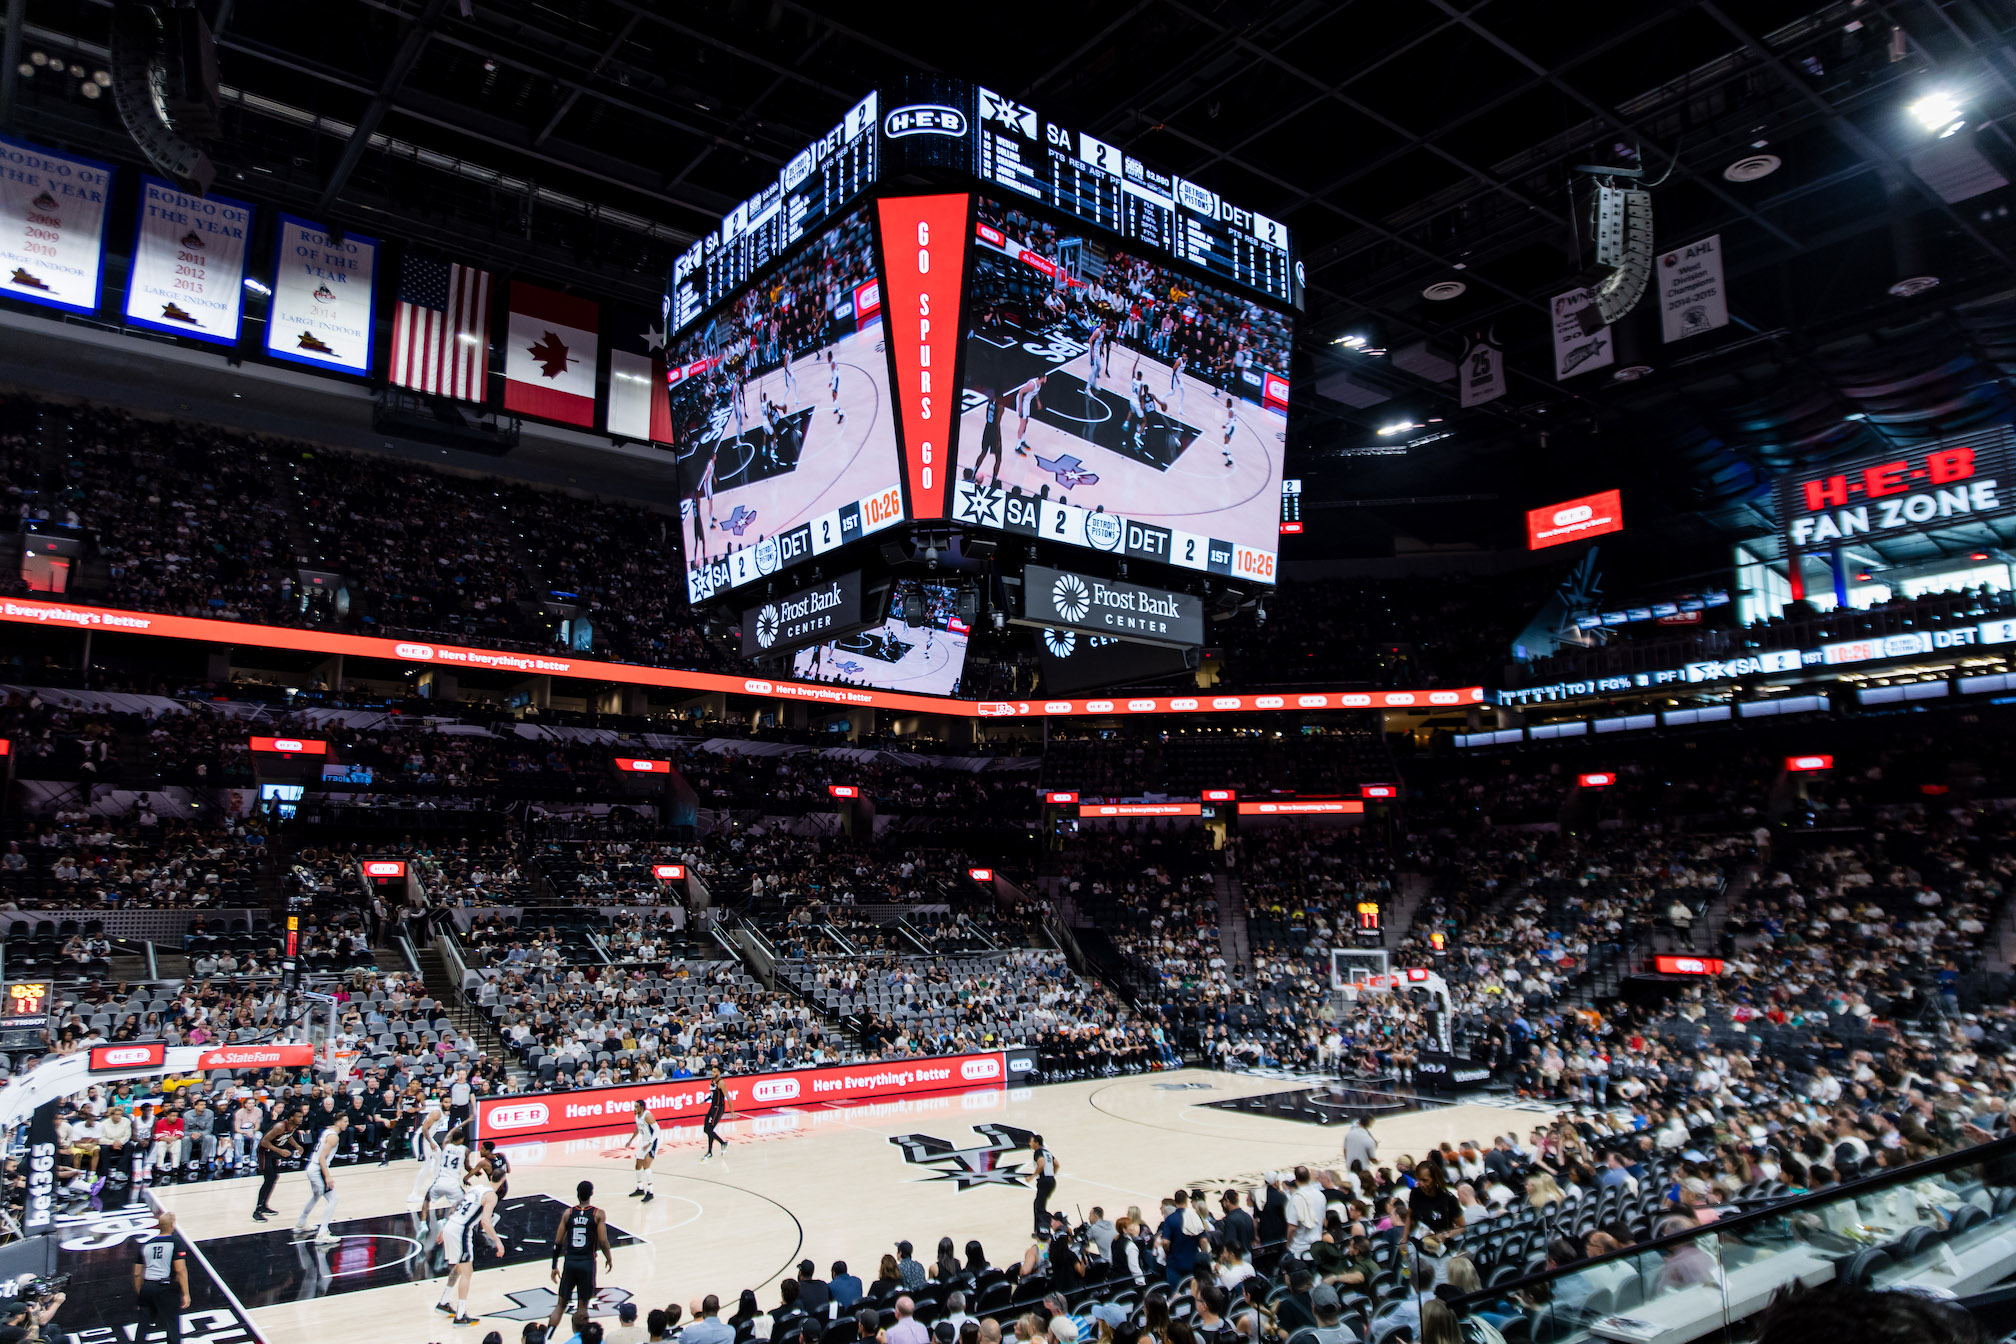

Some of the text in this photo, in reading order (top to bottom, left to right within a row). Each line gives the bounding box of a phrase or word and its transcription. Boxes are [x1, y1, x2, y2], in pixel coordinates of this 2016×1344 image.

[858, 103, 866, 133] 2
[892, 111, 959, 132] H-E-B
[817, 122, 844, 162] DET
[1047, 122, 1071, 151] SA
[822, 124, 876, 173] PTS REB AST PF
[1096, 143, 1107, 170] 2
[1048, 147, 1121, 185] PTS REB AST PF
[0, 166, 102, 203] THE YEAR
[79, 171, 107, 185] OF
[1184, 184, 1209, 202] DETROIT
[1184, 195, 1210, 212] PISTONS
[148, 187, 247, 223] RODEO OF
[1222, 201, 1252, 230] DET
[148, 205, 243, 240] THE YEAR
[732, 212, 739, 237] 2
[1267, 222, 1277, 244] 2
[25, 226, 60, 243] 2009
[704, 231, 720, 256] SA
[1228, 227, 1287, 258] PTS REB AST PF
[24, 241, 57, 258] 2010
[177, 250, 206, 267] 2011
[296, 246, 358, 271] OF THE
[1686, 242, 1715, 260] AHL
[35, 259, 86, 278] INDOOR
[175, 264, 205, 280] 2012
[305, 263, 347, 284] YEAR
[1672, 269, 1708, 287] Division
[1678, 262, 1702, 275] West
[173, 278, 203, 294] 2013
[1667, 276, 1716, 297] Champions
[144, 285, 228, 311] LARGE INDOOR
[310, 305, 337, 320] 2014
[281, 312, 361, 338] LARGE INDOOR
[917, 221, 934, 490] GO SPURS GO
[1471, 351, 1491, 377] 25
[1286, 481, 1293, 492] 2
[1803, 447, 1976, 511] H-E-B
[864, 489, 901, 527] 10:26
[1790, 479, 2000, 546] FAN ZONE
[842, 513, 860, 532] 1ST
[1091, 525, 1116, 540] PISTONS
[1092, 518, 1117, 531] DETROIT
[782, 529, 809, 560] DET
[822, 523, 830, 546] 2
[1006, 498, 1273, 577] SA 2 DET 2 1ST 10:26
[738, 556, 746, 578] 2
[713, 569, 730, 589] SA
[780, 581, 842, 624] Frost Bank
[1092, 582, 1181, 620] Frost Bank
[5, 603, 151, 629] Everything's Better
[787, 615, 832, 638] CENTER
[1104, 612, 1168, 634] CENTER
[1736, 623, 2011, 674] SA 2 1ST 10:26 DET 2
[438, 649, 467, 662] Here
[467, 652, 535, 670] Everything's
[536, 658, 570, 673] Better
[1566, 683, 1585, 694] TO
[1598, 677, 1631, 691] FG%
[1655, 670, 1676, 683] PF
[776, 684, 873, 703] Here Everything's Better
[15, 1018, 47, 1026] TISSOT
[114, 1052, 144, 1062] H-E-B
[225, 1051, 281, 1066] StateFarm
[1419, 1062, 1447, 1074] KIA
[1454, 1069, 1491, 1083] ticketmaster
[497, 1108, 541, 1123] H-E-B
[565, 1103, 603, 1118] Here
[605, 1093, 693, 1116] Everthing's
[759, 1084, 794, 1096] H-E-B
[813, 1078, 843, 1092] Here
[844, 1071, 914, 1091] Everything's
[916, 1066, 951, 1082] Better
[443, 1155, 459, 1169] 14
[28, 1142, 55, 1228] bet365
[572, 1227, 587, 1248] 5
[153, 1246, 164, 1260] 12
